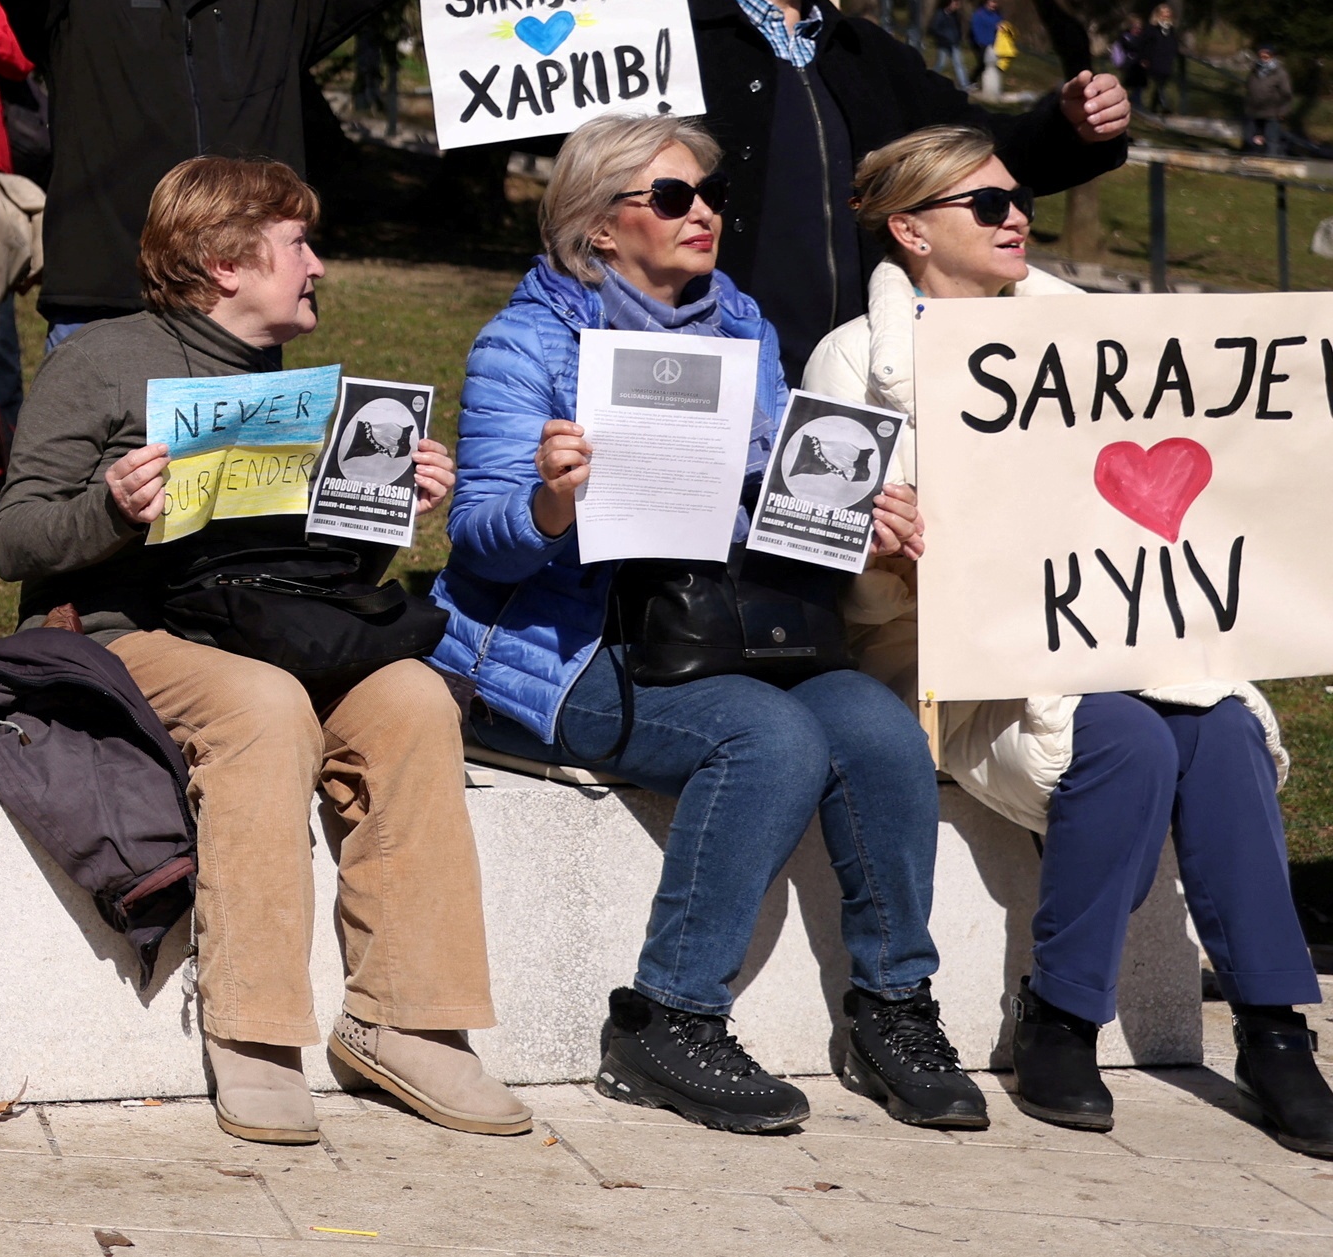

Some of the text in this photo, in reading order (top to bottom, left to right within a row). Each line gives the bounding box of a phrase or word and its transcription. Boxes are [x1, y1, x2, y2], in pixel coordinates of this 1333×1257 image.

[619, 392, 661, 401] SOLIDARNOST
[665, 396, 711, 405] DOSTOJANSTVO
[174, 390, 313, 442] NEVER
[323, 477, 411, 501] PROBUDI SE BOSNO
[767, 492, 870, 526] PROBUDI SE BOSNO
[1044, 535, 1245, 652] KYIV
